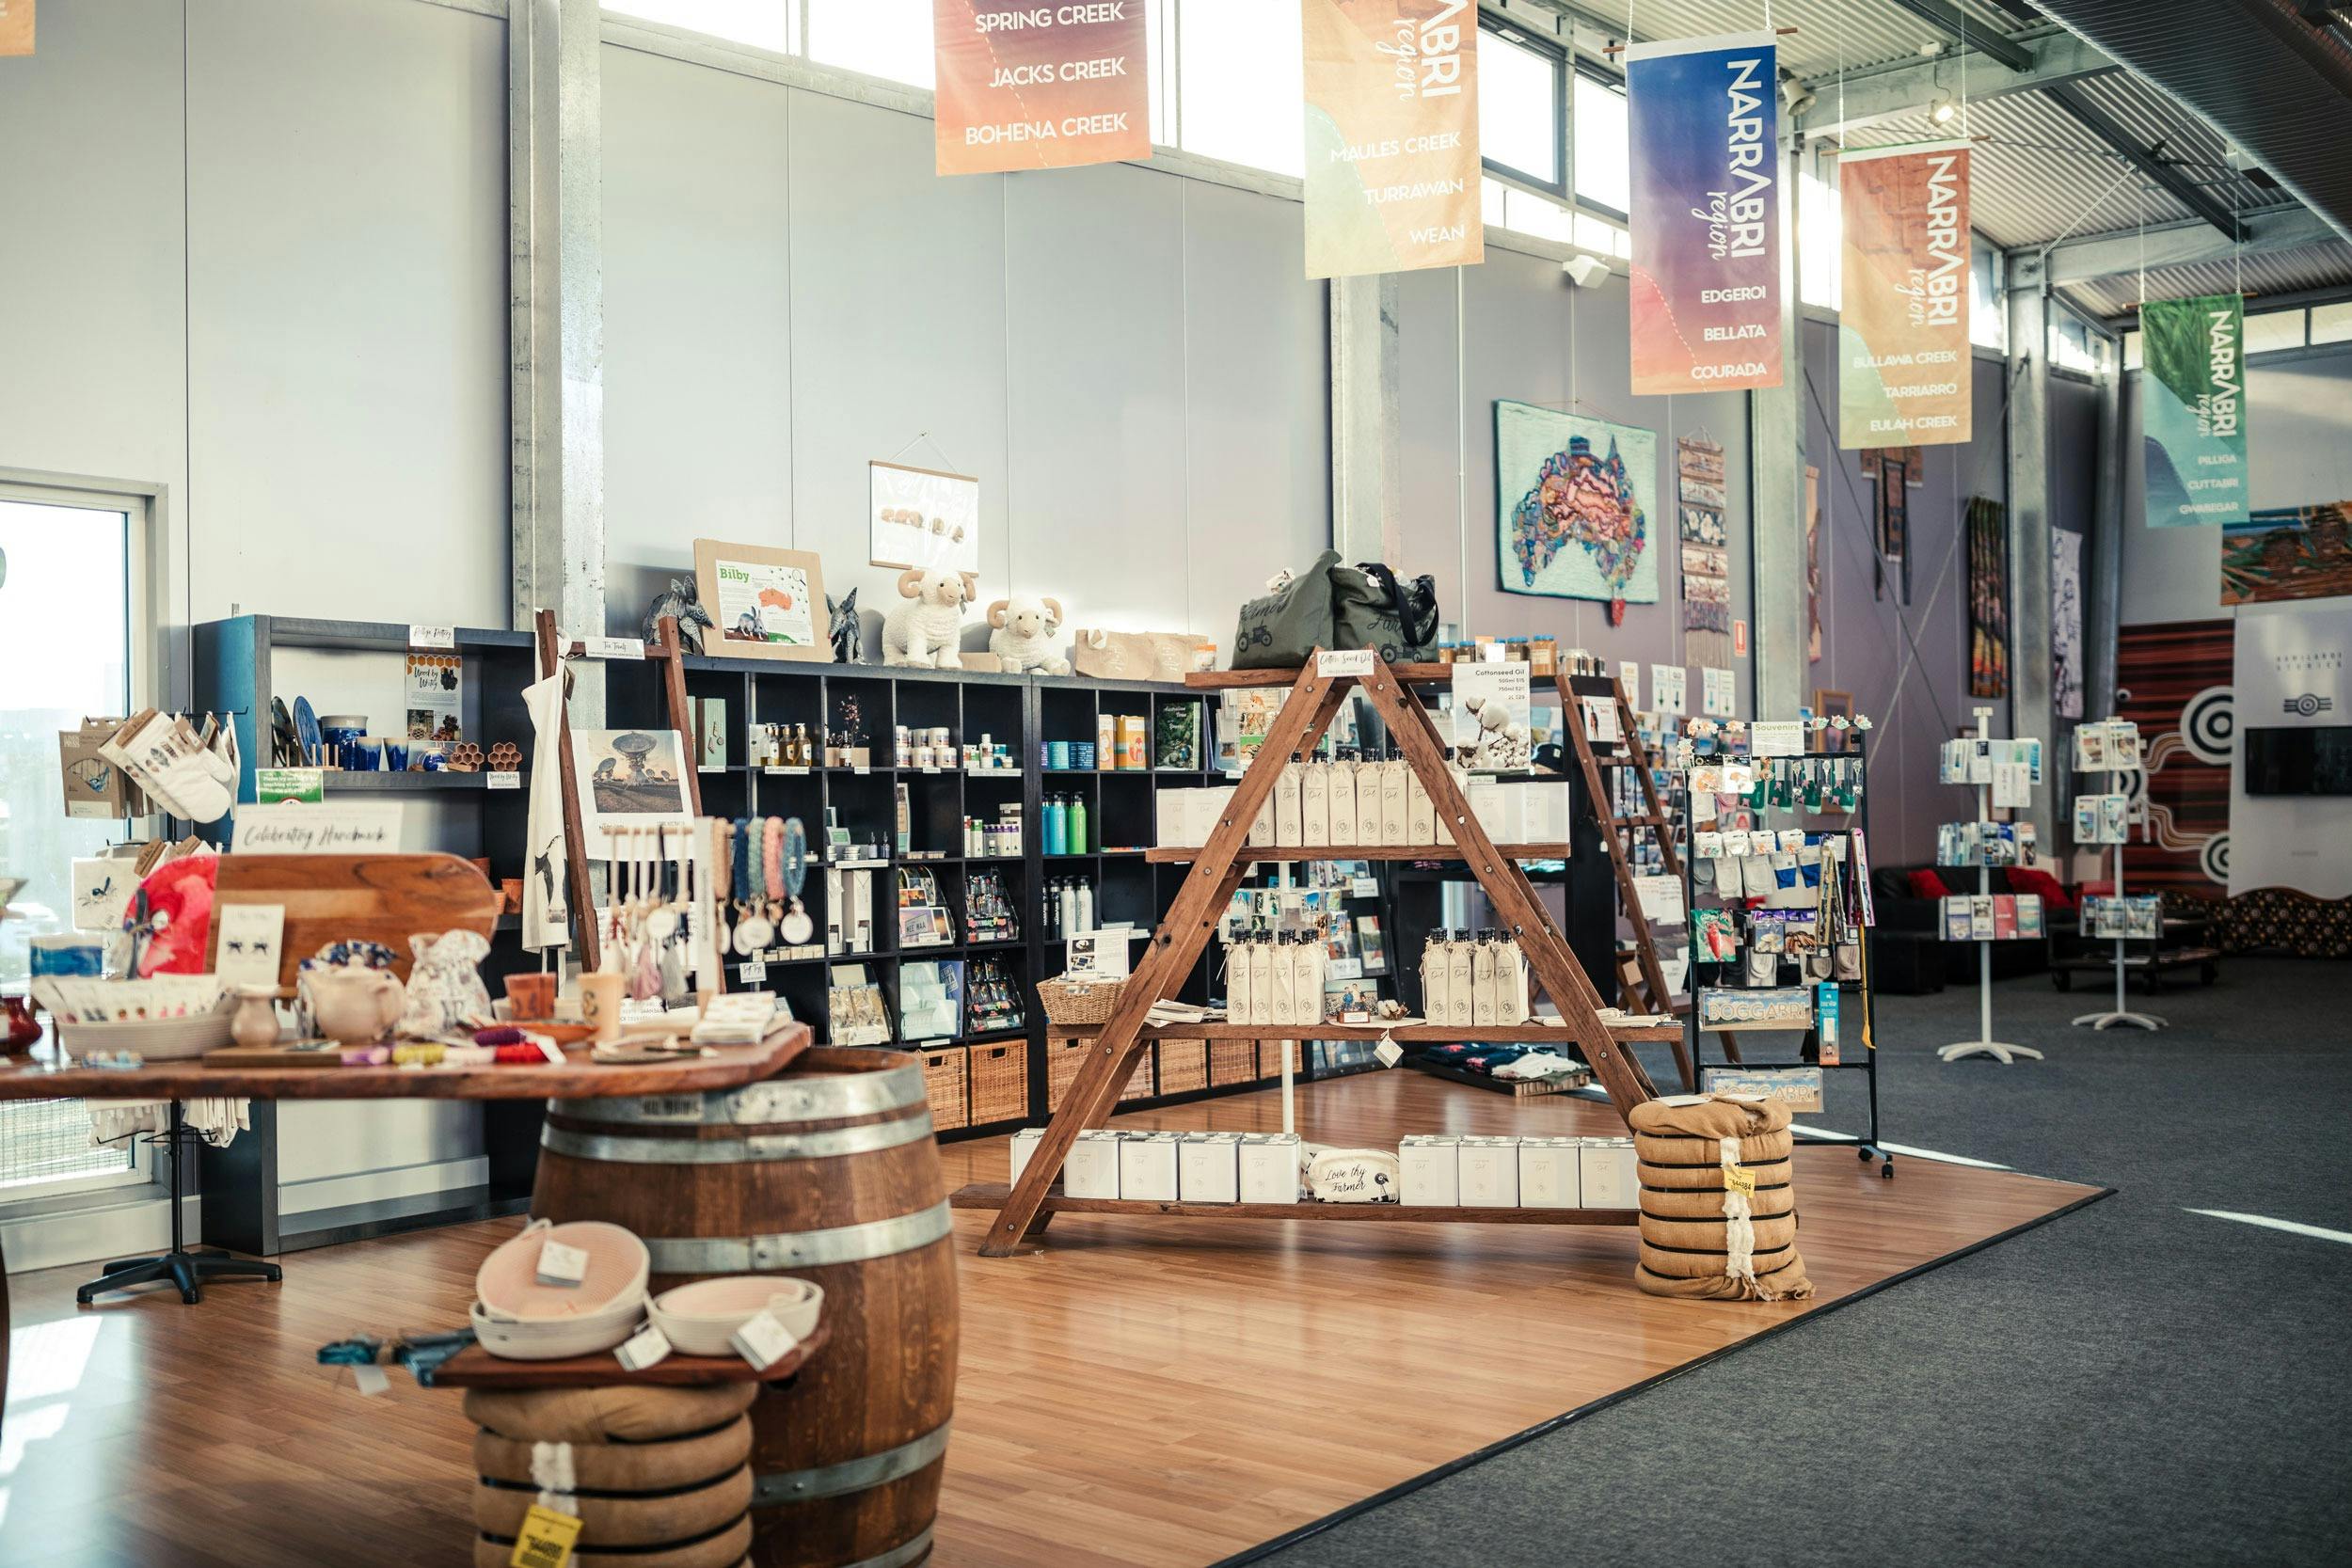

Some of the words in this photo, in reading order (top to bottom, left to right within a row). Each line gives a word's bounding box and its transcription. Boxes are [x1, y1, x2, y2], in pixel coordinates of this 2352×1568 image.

[975, 8, 1052, 33] SPRING
[1057, 2, 1125, 26] CREEK
[1375, 18, 1419, 103] region
[989, 65, 1055, 87] JACKS
[1059, 56, 1127, 81] CREEK
[965, 120, 1057, 145] BOHENA
[1061, 112, 1128, 136] CREEK
[1330, 140, 1400, 163] MAULES
[1405, 132, 1461, 154] CREEK
[1726, 58, 1772, 258] NARRABRI
[1363, 178, 1464, 205] TURRAWAN
[1410, 224, 1465, 245] WEAN
[1692, 191, 1728, 261] region
[1927, 155, 1964, 326] NARRABRI
[1701, 286, 1766, 303] EDGEROI
[1895, 268, 1926, 329] region
[1703, 325, 1766, 341] BELLATA
[1852, 353, 1914, 369] BULLAWA
[1916, 350, 1957, 365] CREEK
[1691, 363, 1767, 379] COURADA
[1883, 383, 1957, 399] TARRIARRO
[1869, 419, 1914, 432] EULAH
[1915, 415, 1957, 429] CREEK
[2198, 454, 2237, 466] PILLIGA
[2186, 479, 2238, 490] CUTTABRI
[2179, 502, 2239, 515] GWABEGAR
[720, 568, 749, 583] Bilby
[1366, 614, 1432, 635] Farer
[245, 825, 313, 849] Celebrating
[1708, 1001, 1806, 1022] BOGGABRI
[1325, 1169, 1347, 1181] Love
[1351, 1164, 1366, 1182] thy
[1331, 1180, 1366, 1193] Farmer
